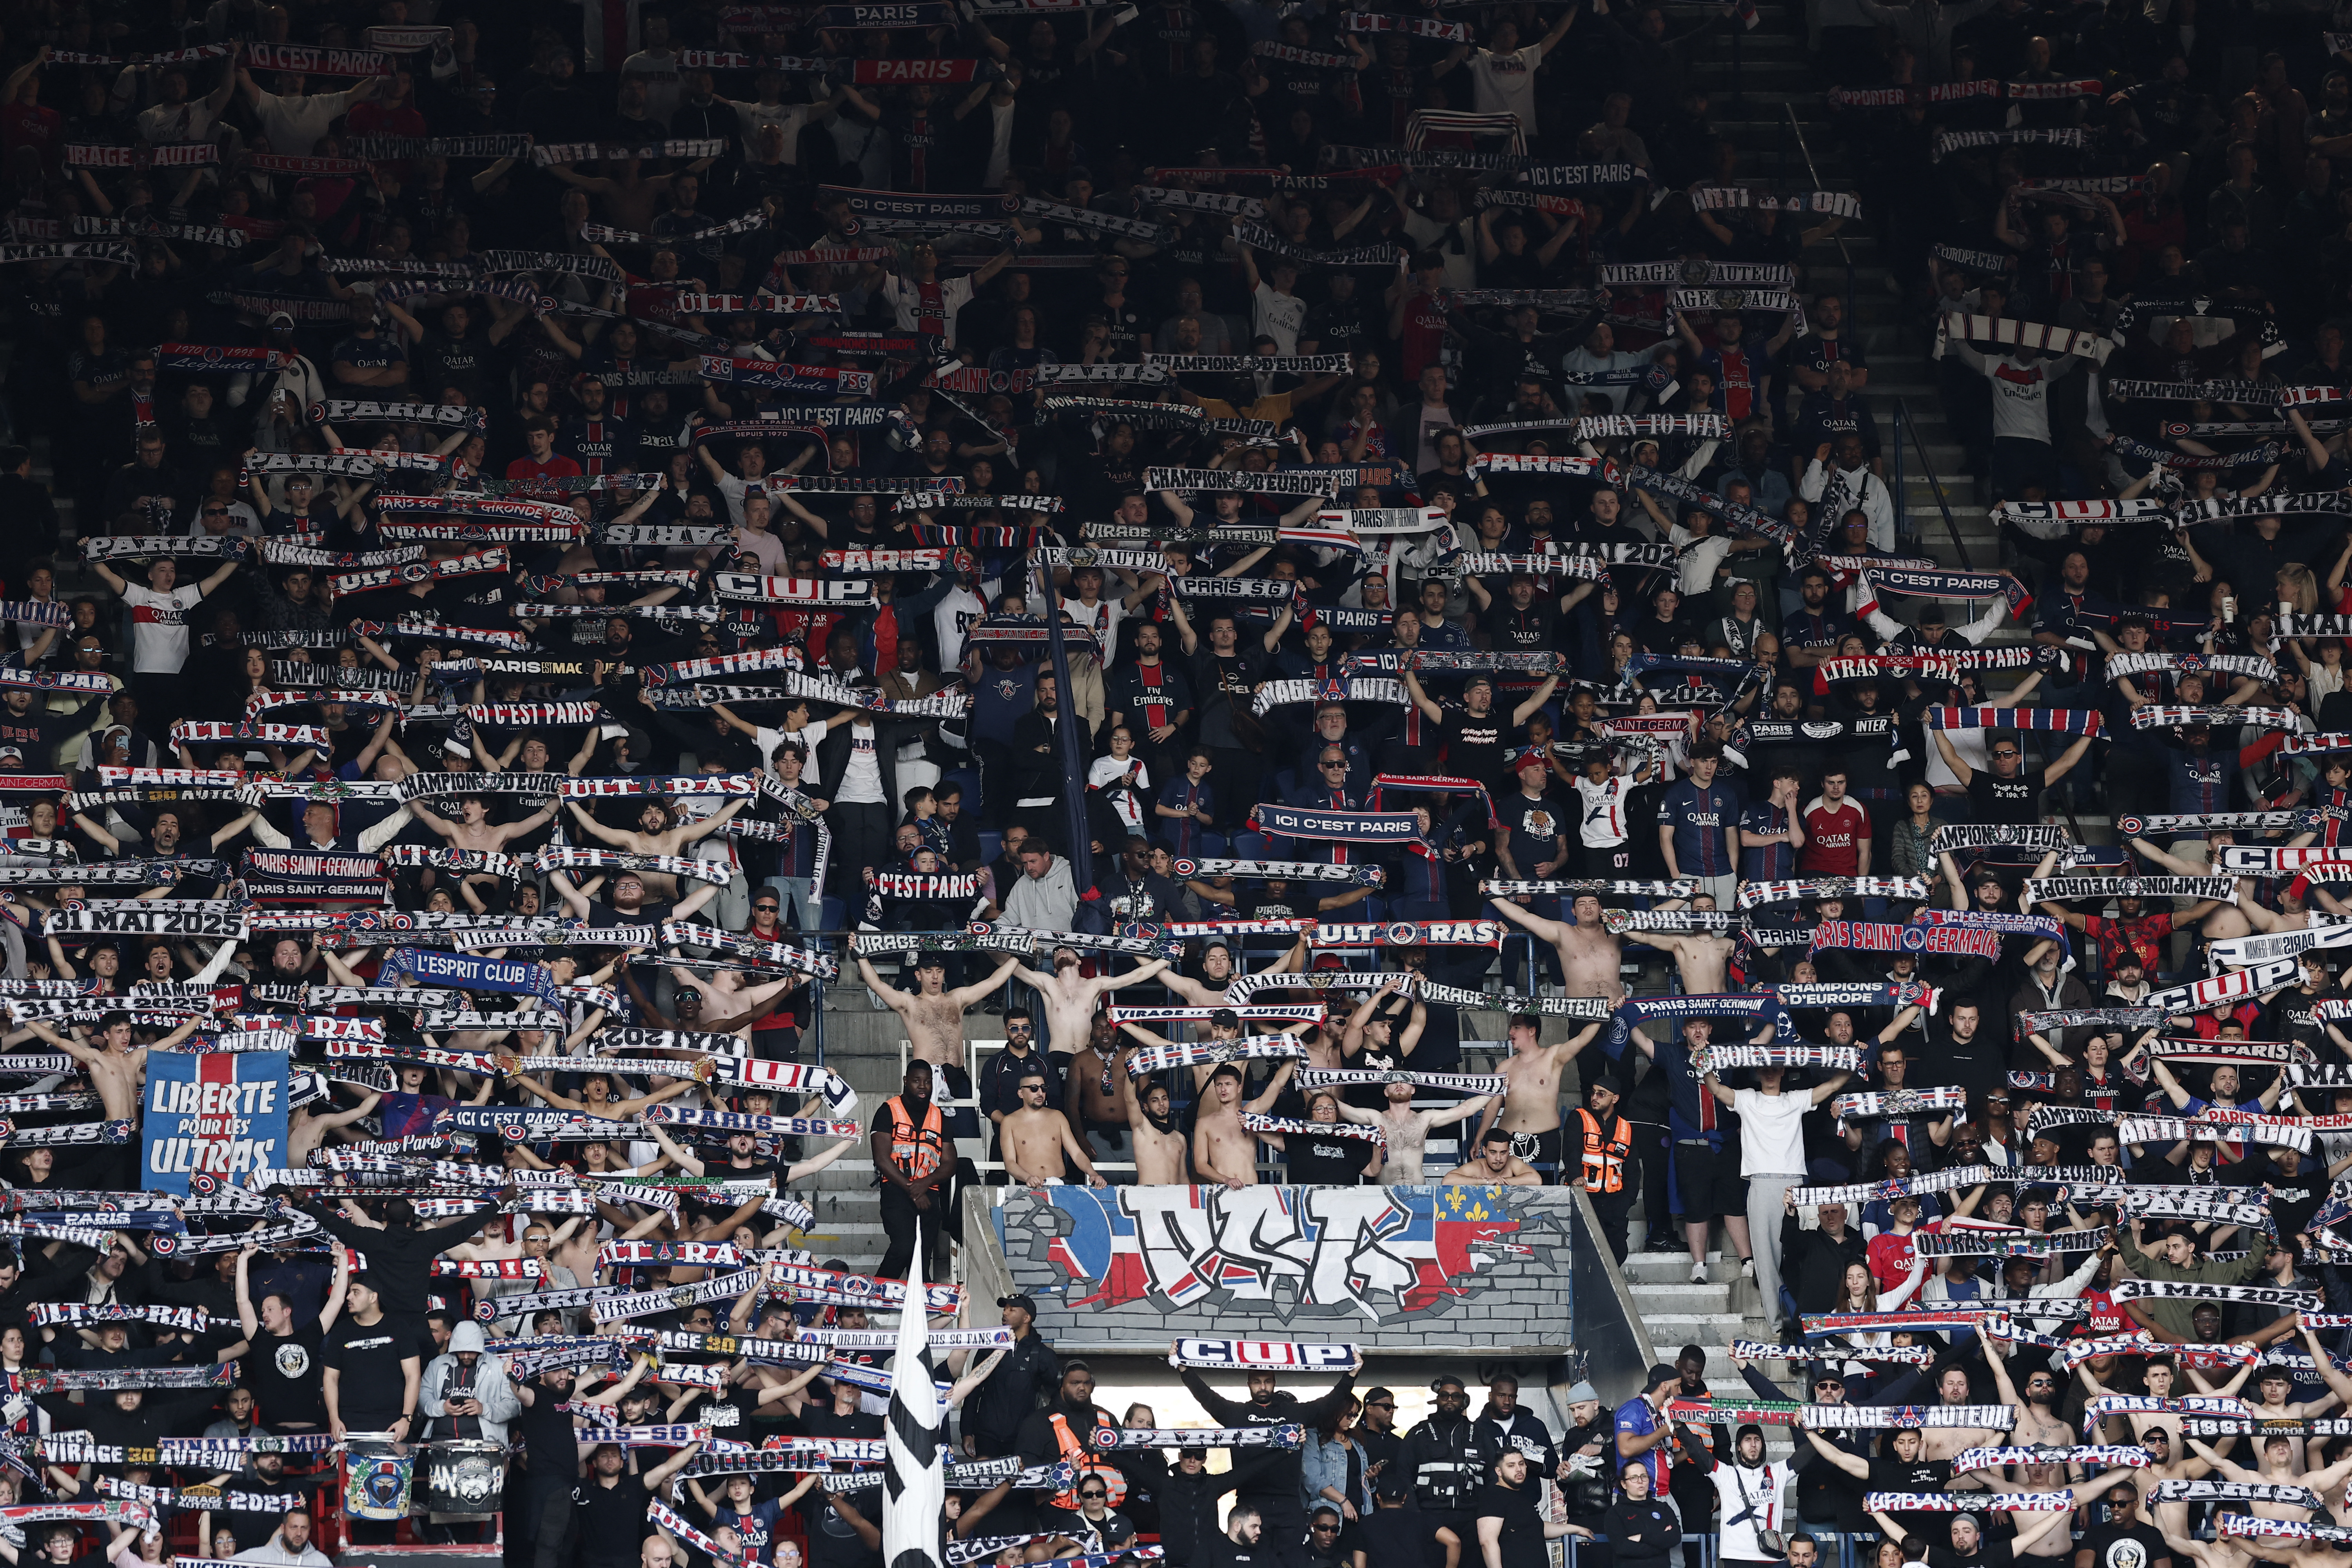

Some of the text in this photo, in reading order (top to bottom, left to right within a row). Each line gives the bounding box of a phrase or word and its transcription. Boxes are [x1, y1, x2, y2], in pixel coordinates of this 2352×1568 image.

[855, 6, 918, 20] PARIS
[249, 43, 384, 74] ICI C'EST PARIS!
[877, 61, 953, 78] PARIS
[536, 139, 723, 165] ANTI OM
[1271, 175, 1328, 189] PARIS
[1532, 164, 1630, 185] ICI C'EST PARIS
[874, 201, 981, 214] C'EST PARIS
[1606, 265, 1792, 283] VIRAGE AUTEUIL
[911, 307, 950, 319] OPEL
[176, 345, 254, 356] 1970 1998
[810, 337, 916, 350] CHAMPIONS D'EUROPE
[168, 357, 255, 369] Legende
[702, 358, 732, 374] PSG
[746, 360, 826, 376] 1970 1998
[741, 374, 828, 391] Legende
[839, 373, 870, 389] PSG
[2016, 385, 2029, 395] Fly
[846, 408, 885, 424] PARIS
[1822, 419, 1857, 428] QATAR
[577, 443, 612, 453] QATAR
[2134, 445, 2261, 467] SONS OF PANAME
[1253, 474, 1332, 496] D'EUROPE
[1360, 468, 1391, 485] PARIS
[421, 499, 542, 519] SG GIRONDE
[1352, 509, 1419, 528] PARIS SAINT-GERMAIN
[382, 525, 577, 541] VIRAGE AUTEUIL
[1085, 523, 1275, 544] VIRAGE AUTEUIL
[85, 536, 220, 563] PARIS
[716, 572, 868, 600] CUP
[1184, 580, 1283, 595] PARIS S.G.
[1891, 573, 2000, 590] C'EST PARIS
[719, 593, 784, 604] COLLECTIF
[152, 610, 182, 621] QATAR
[1147, 686, 1160, 694] Fly
[1133, 694, 1174, 706] Emirates
[496, 702, 593, 724] C'EST PARIS
[1856, 719, 1886, 732] INTER
[1276, 815, 1412, 832] ICI C'EST PARIS
[1687, 812, 1719, 822] QATAR
[255, 854, 379, 878] PARIS SAINT-GERMAIN
[1613, 853, 1628, 867] 07
[249, 884, 383, 895] PARIS SAINT-GERMAIN
[880, 873, 975, 898] C'EST PARIS
[54, 909, 243, 936] 31 MAI 2025
[1853, 922, 1902, 951] SAINT
[417, 954, 525, 982] L'ESPRIT CLUB
[1779, 983, 1882, 993] CHAMPIONS
[1421, 982, 1610, 1020] VIRAGE AUTEUIL
[1635, 999, 1764, 1013] PARIS SAINT-GERMAIN
[1789, 993, 1872, 1004] D'EUROPE
[2152, 1039, 2287, 1058] ALLEZ PARIS
[1710, 1046, 1857, 1070] BORN TO WIN
[152, 1080, 278, 1114] LIBERTE
[2085, 1089, 2120, 1097] Emirates
[178, 1119, 250, 1134] POUR LES
[457, 1112, 475, 1126] ICI
[150, 1138, 275, 1173] ULTRAS
[710, 1185, 765, 1195] DE GAZA
[441, 1259, 541, 1278] PARIS
[2120, 1282, 2319, 1309] 31 MAI 2025
[821, 1332, 991, 1345] BY ORDER OF SG FANS
[706, 1336, 826, 1361] 30 AUTEUIL
[1178, 1340, 1352, 1364] CUP
[1734, 1341, 1813, 1359] URBAN
[1711, 1398, 1748, 1410] NOUS
[1248, 1415, 1286, 1423] Champion
[1709, 1411, 1733, 1423] DES
[1801, 1406, 2015, 1431] VIRAGE AUTEUIL
[1123, 1427, 1267, 1447] PARIS
[44, 1442, 244, 1470] VIRAGE 30 AUTEUIL
[682, 1449, 819, 1475] COLLECTIF
[179, 1495, 222, 1503] VIRAGE
[1869, 1490, 2071, 1512] URBAN PARIS
[2162, 1480, 2311, 1506] PARIS
[178, 1501, 223, 1510] AUTEUIL
[2227, 1515, 2312, 1539] URBAN
